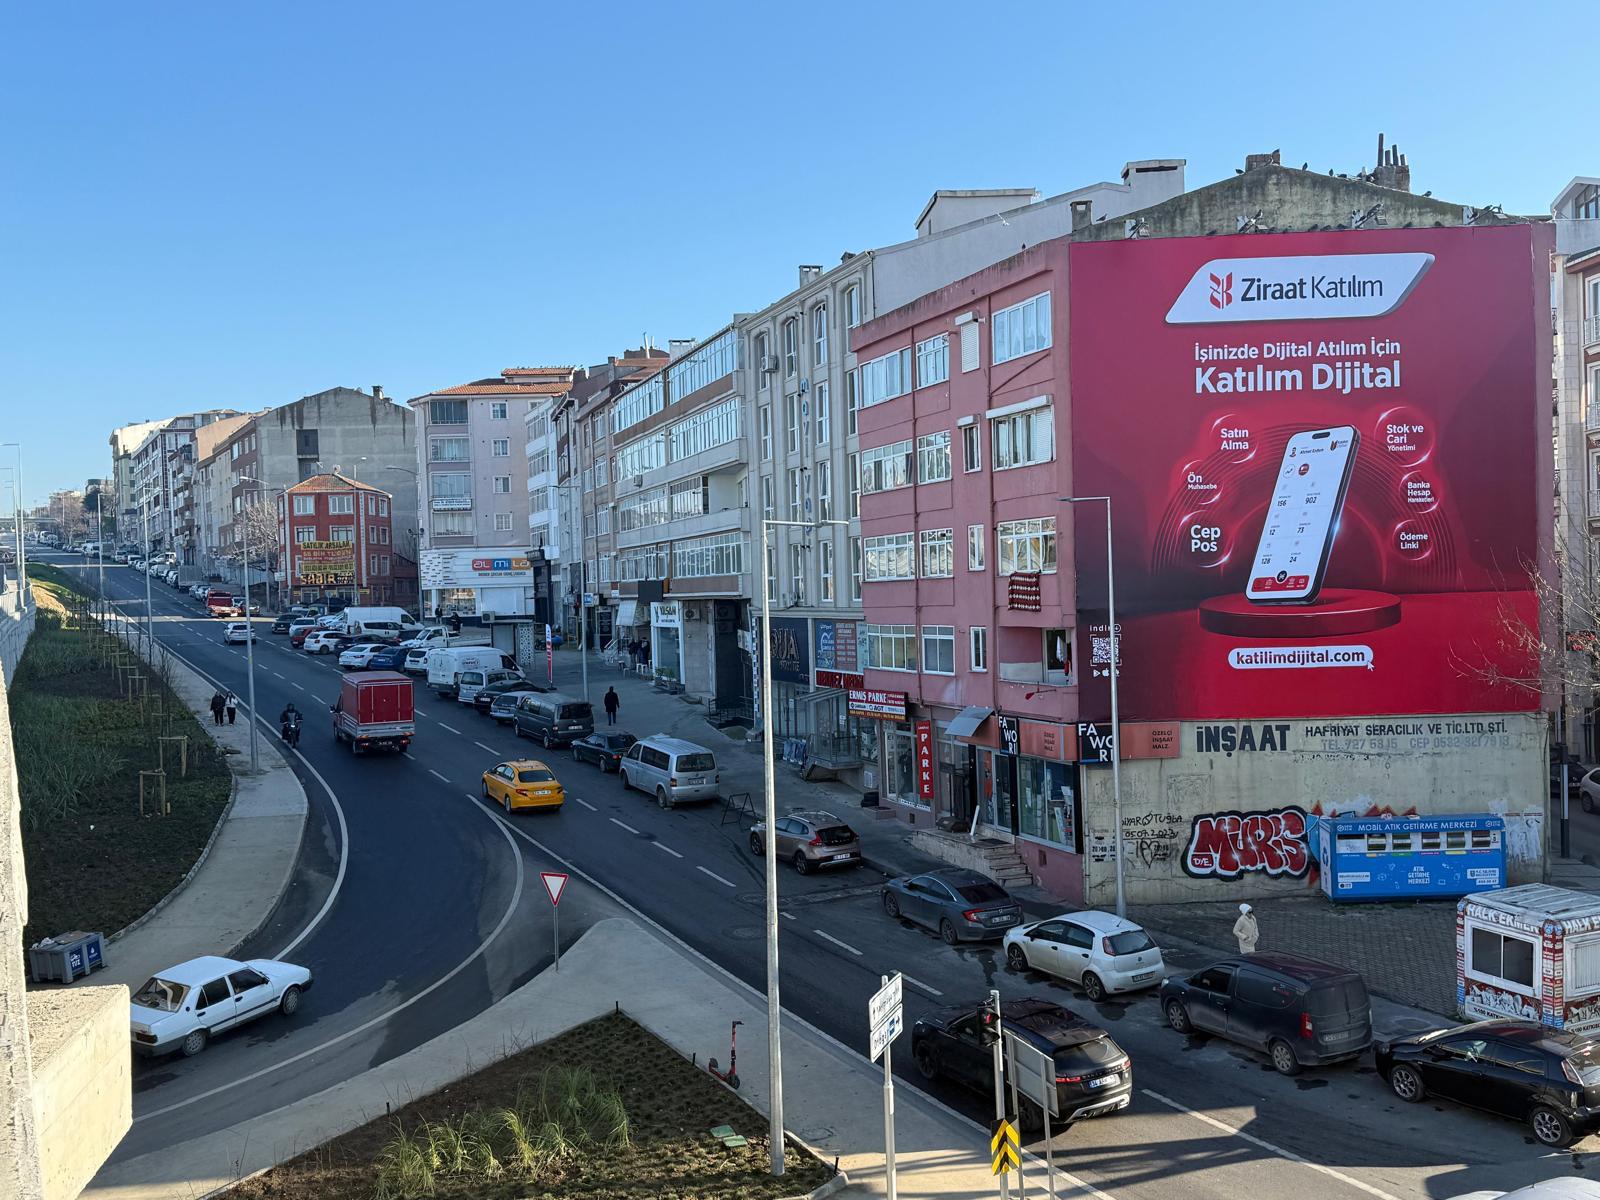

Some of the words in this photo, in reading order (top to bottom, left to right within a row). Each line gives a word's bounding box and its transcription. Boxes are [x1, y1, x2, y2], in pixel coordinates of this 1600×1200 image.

[1241, 278, 1306, 302] Ziraat
[1312, 275, 1383, 298] Katılım
[1195, 343, 1258, 362] İşinizde
[1263, 341, 1311, 360] Dijital
[1316, 340, 1366, 356] Atılım
[1371, 337, 1400, 357] İçin
[1195, 365, 1302, 393] Katılım
[1312, 360, 1400, 394] Dijital
[1220, 429, 1248, 438] Satın
[1387, 424, 1409, 433] Stok
[1220, 440, 1248, 449] Alma
[1387, 434, 1407, 443] Cari
[1187, 472, 1202, 482] Ön
[1190, 525, 1221, 540] Cep
[1400, 532, 1428, 540] Ödeme
[1191, 540, 1217, 552] Pos
[1236, 649, 1365, 666] katilimdijital.com
[868, 692, 886, 703] PARKE
[999, 717, 1007, 728] FA
[1004, 729, 1017, 742] WO
[1078, 723, 1097, 736] FA
[1196, 725, 1290, 757] İNŞAAT
[1305, 724, 1359, 737] HAFRİYAT
[1365, 722, 1423, 736] SERACILIK
[1427, 723, 1442, 734] VE
[1487, 719, 1508, 736] ŞTİ.
[1409, 737, 1430, 748] CEP
[920, 733, 930, 793] PARKE
[1358, 823, 1382, 832] MOBİL
[1385, 823, 1401, 831] ATIK
[1402, 820, 1438, 830] GETİRME
[1441, 818, 1477, 829] MERKEZİ
[1467, 904, 1496, 922] HALK
[1562, 917, 1589, 934] HALK
